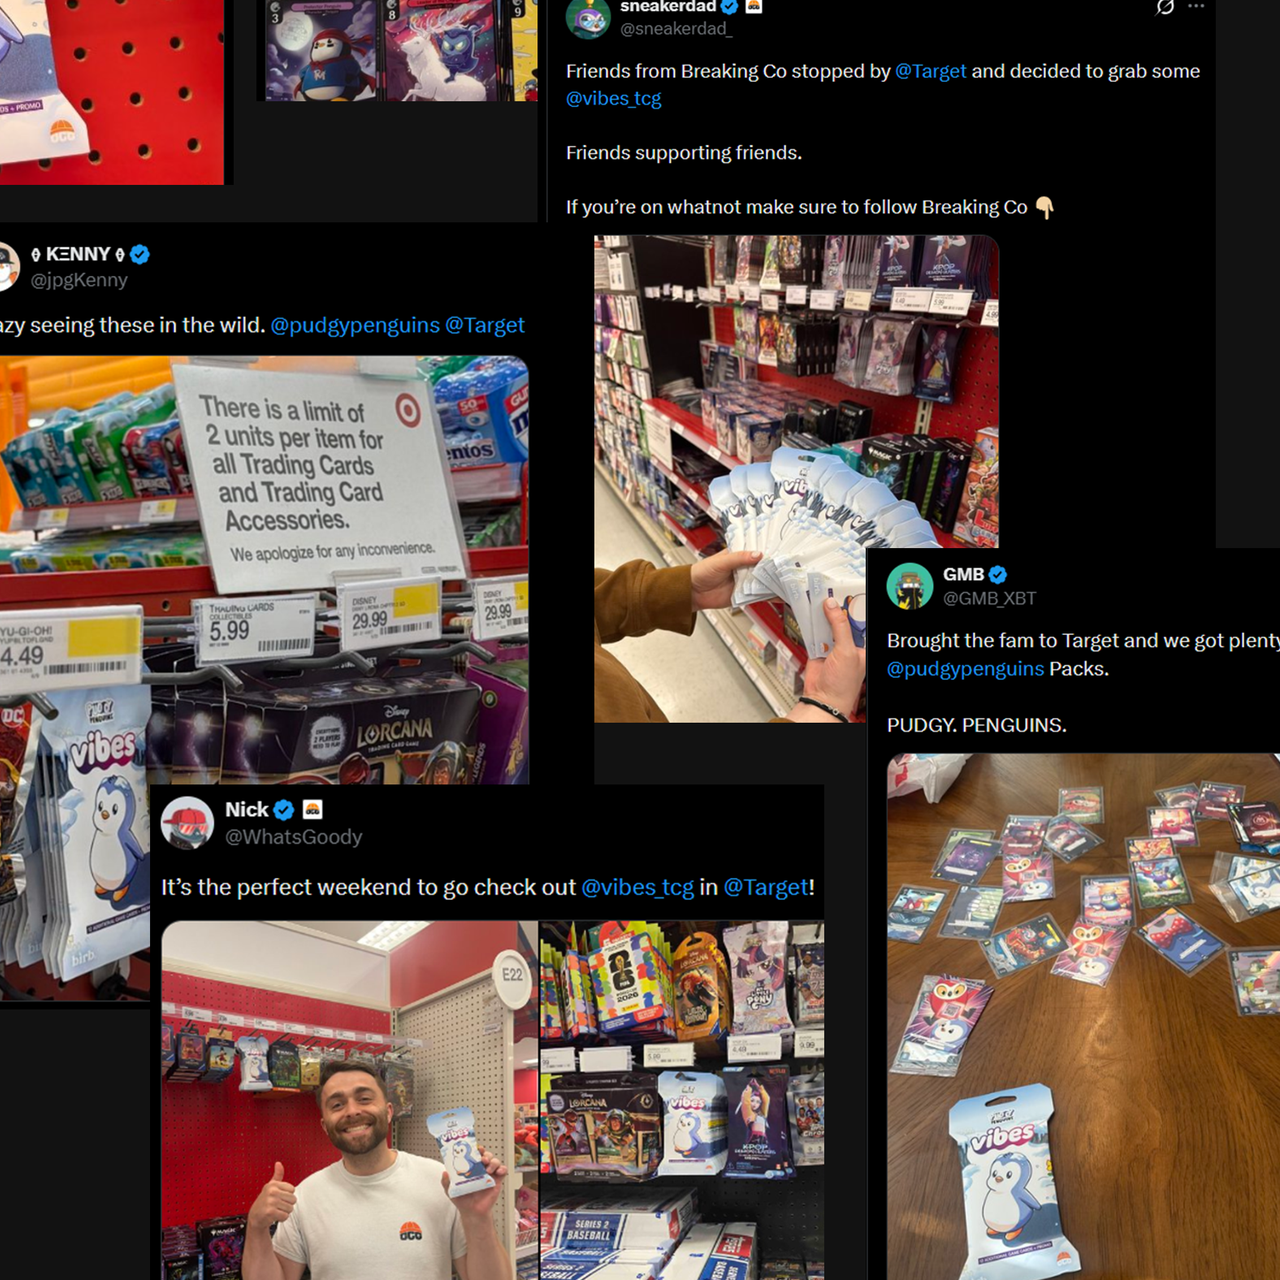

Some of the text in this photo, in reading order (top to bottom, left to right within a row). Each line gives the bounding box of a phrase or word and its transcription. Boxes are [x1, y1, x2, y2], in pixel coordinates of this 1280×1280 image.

[199, 394, 364, 423] There is a limit of
[206, 424, 383, 452] 2 units per item for
[213, 452, 374, 479] all Trading Cards
[219, 481, 383, 506] and Trading Card
[225, 510, 349, 531] Accessories.
[230, 542, 436, 563] We apologize for any inconvenience.
[352, 596, 377, 605] DISNEY
[352, 611, 387, 629] 29.99
[0, 626, 53, 636] YU-GI-OH!
[209, 620, 250, 641] 5.99
[0, 646, 44, 666] 4.49
[2, 707, 24, 724] DC
[887, 717, 1068, 733] PUDGY. PENGUINS.
[357, 718, 433, 748] LORCANA
[70, 730, 138, 773] vibes
[225, 800, 270, 818] Nick
[502, 968, 524, 982] E22
[575, 1219, 608, 1229] SERIES 2
[567, 1229, 611, 1242] BASEBALL
